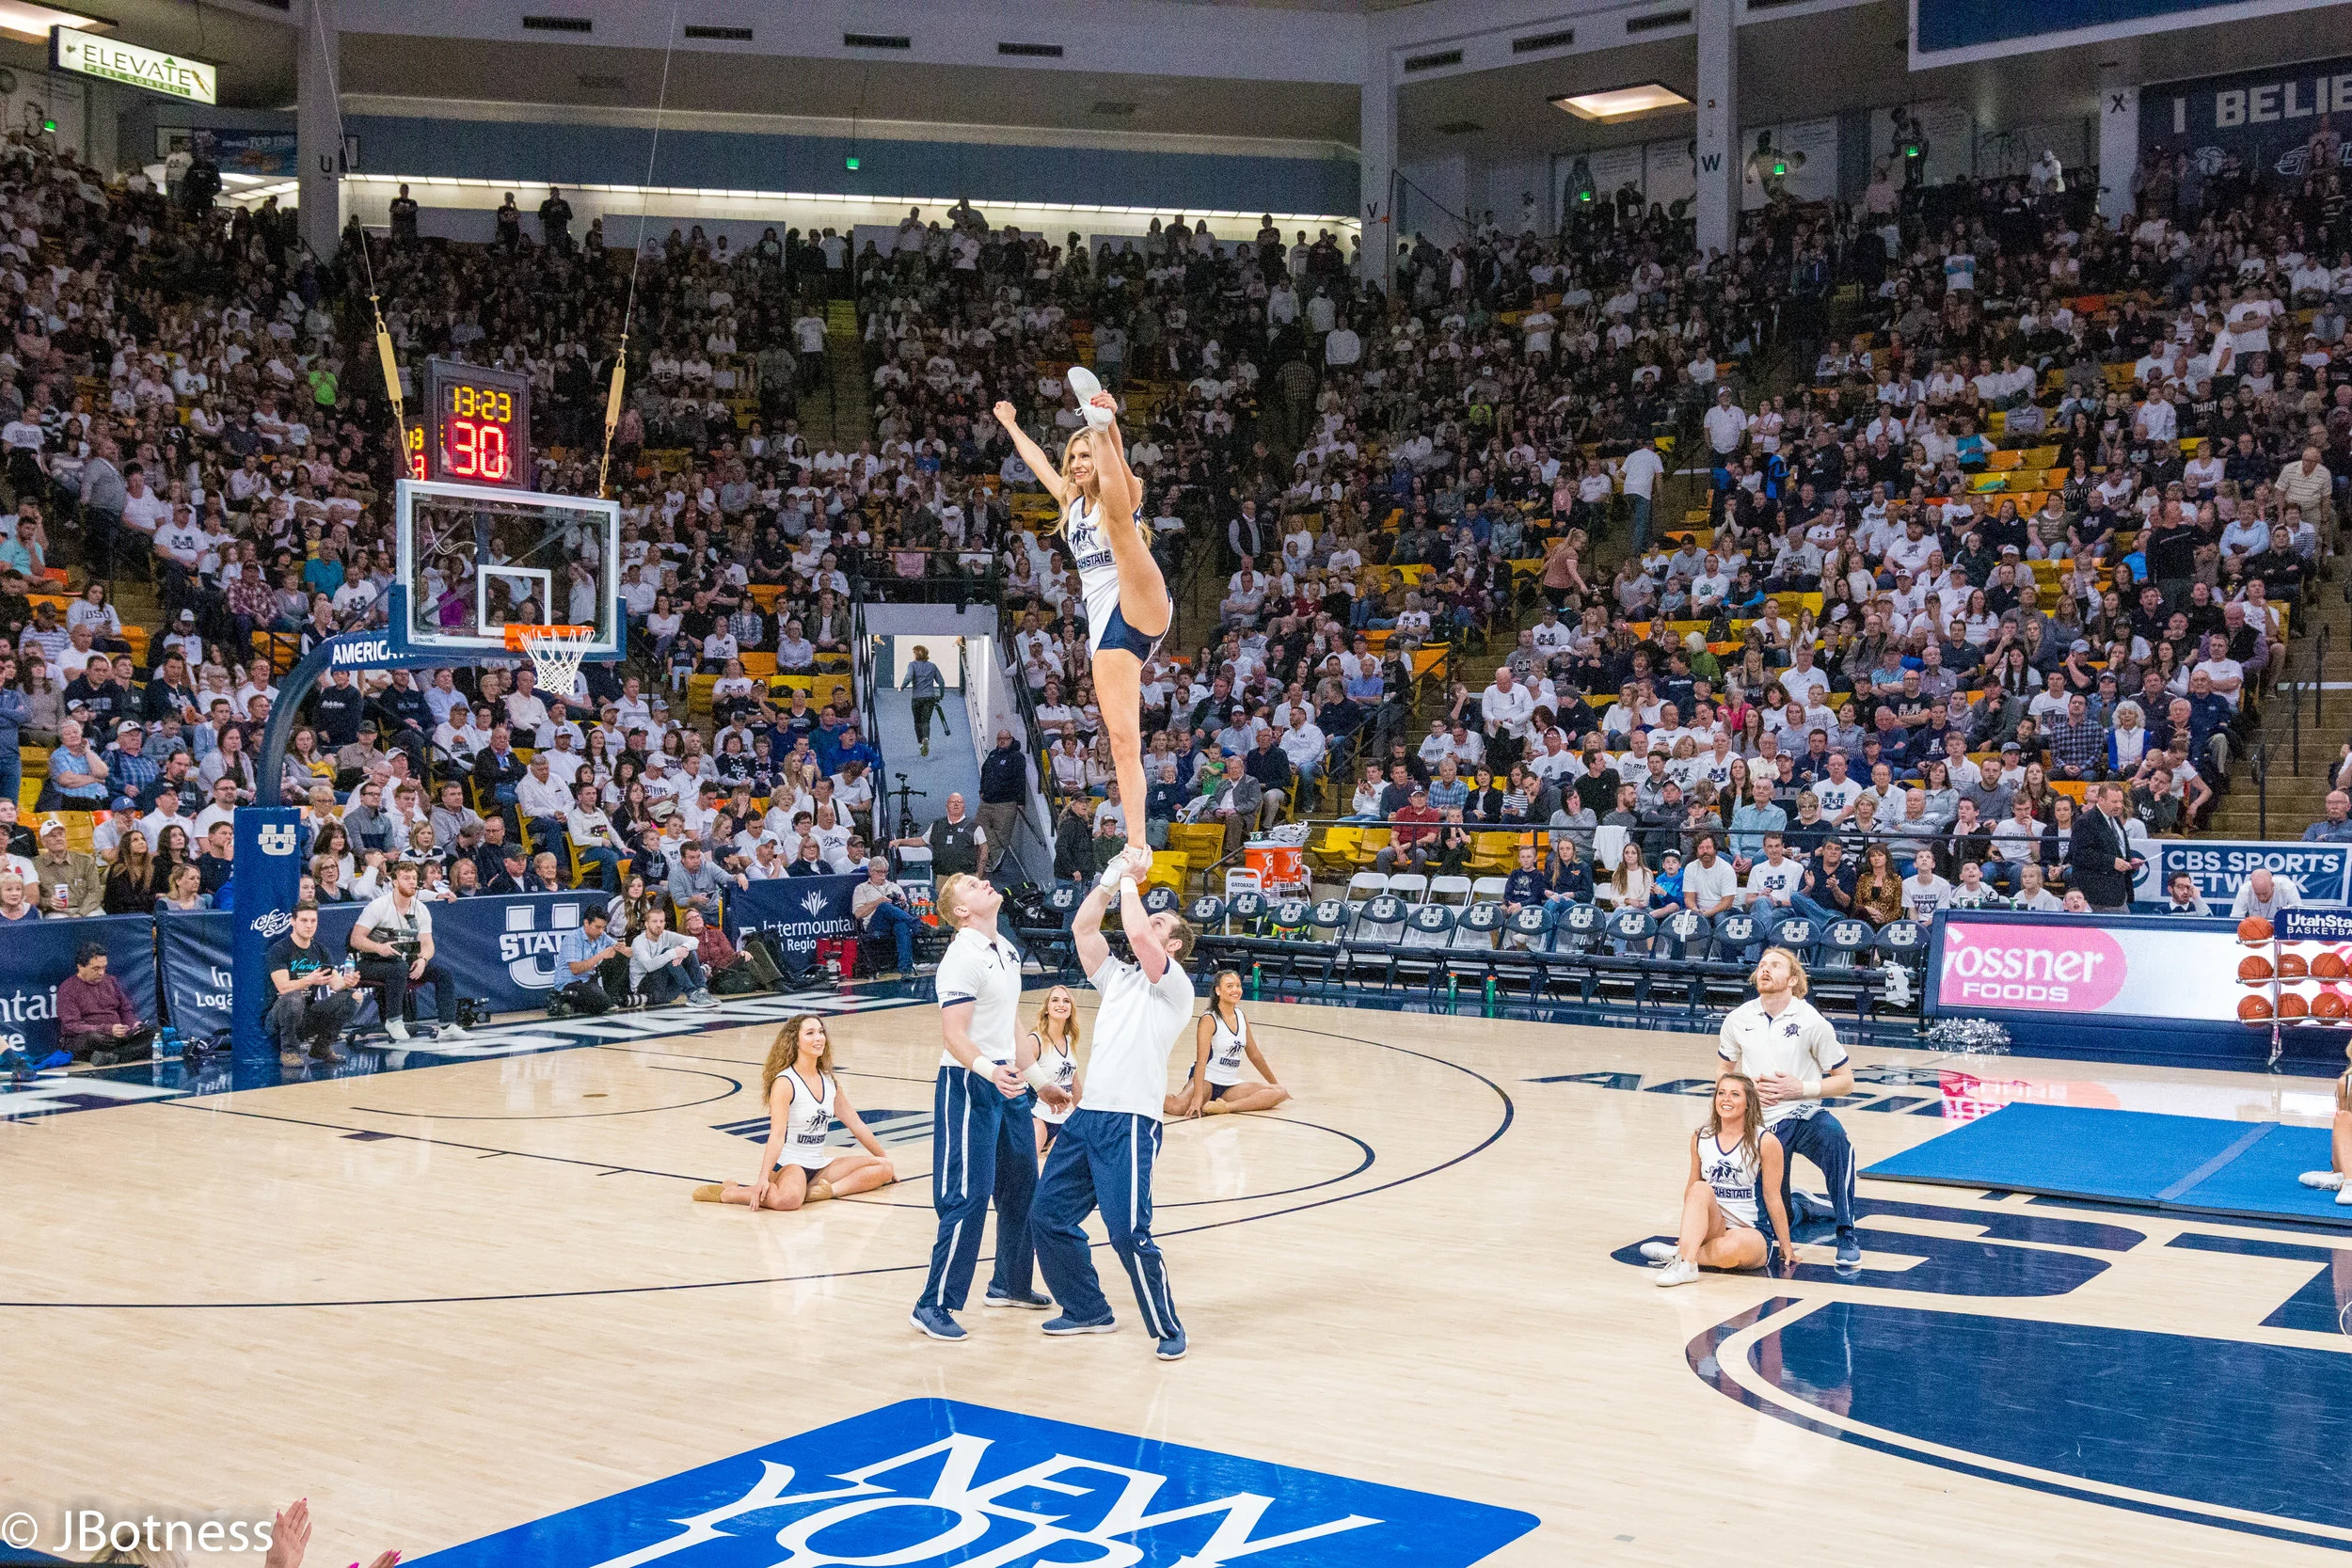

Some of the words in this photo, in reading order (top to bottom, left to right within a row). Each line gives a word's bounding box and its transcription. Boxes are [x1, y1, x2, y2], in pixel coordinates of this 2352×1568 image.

[84, 44, 191, 87] ELEVATE
[86, 65, 119, 79] PEST
[127, 73, 187, 94] CONTROL
[2110, 93, 2126, 113] X
[2174, 98, 2185, 134] I
[320, 156, 332, 172] U
[1701, 153, 1722, 172] W
[1367, 202, 1377, 218] V
[454, 386, 512, 423] 13:23
[409, 427, 424, 451] 13
[455, 421, 504, 479] 30
[1087, 548, 1112, 566] STATE
[1805, 713, 1827, 721] GGIES
[258, 832, 297, 846] STATE
[1265, 854, 1273, 866] G
[1295, 853, 1301, 865] G
[2167, 850, 2221, 871] CBS
[2228, 851, 2340, 873] SPORTS
[1764, 879, 1787, 887] STATE
[1372, 904, 1396, 912] STATE
[1569, 912, 1594, 921] STATE
[1620, 919, 1645, 927] STATE
[1726, 924, 1752, 932] STATE
[1782, 927, 1809, 936] STATE
[1888, 929, 1916, 938] STATE
[500, 929, 568, 962] STAT
[787, 936, 817, 954] Regio
[1963, 982, 2070, 1003] FOODS
[1725, 1186, 1753, 1199] STATE
[827, 1432, 1386, 1561] NEW
